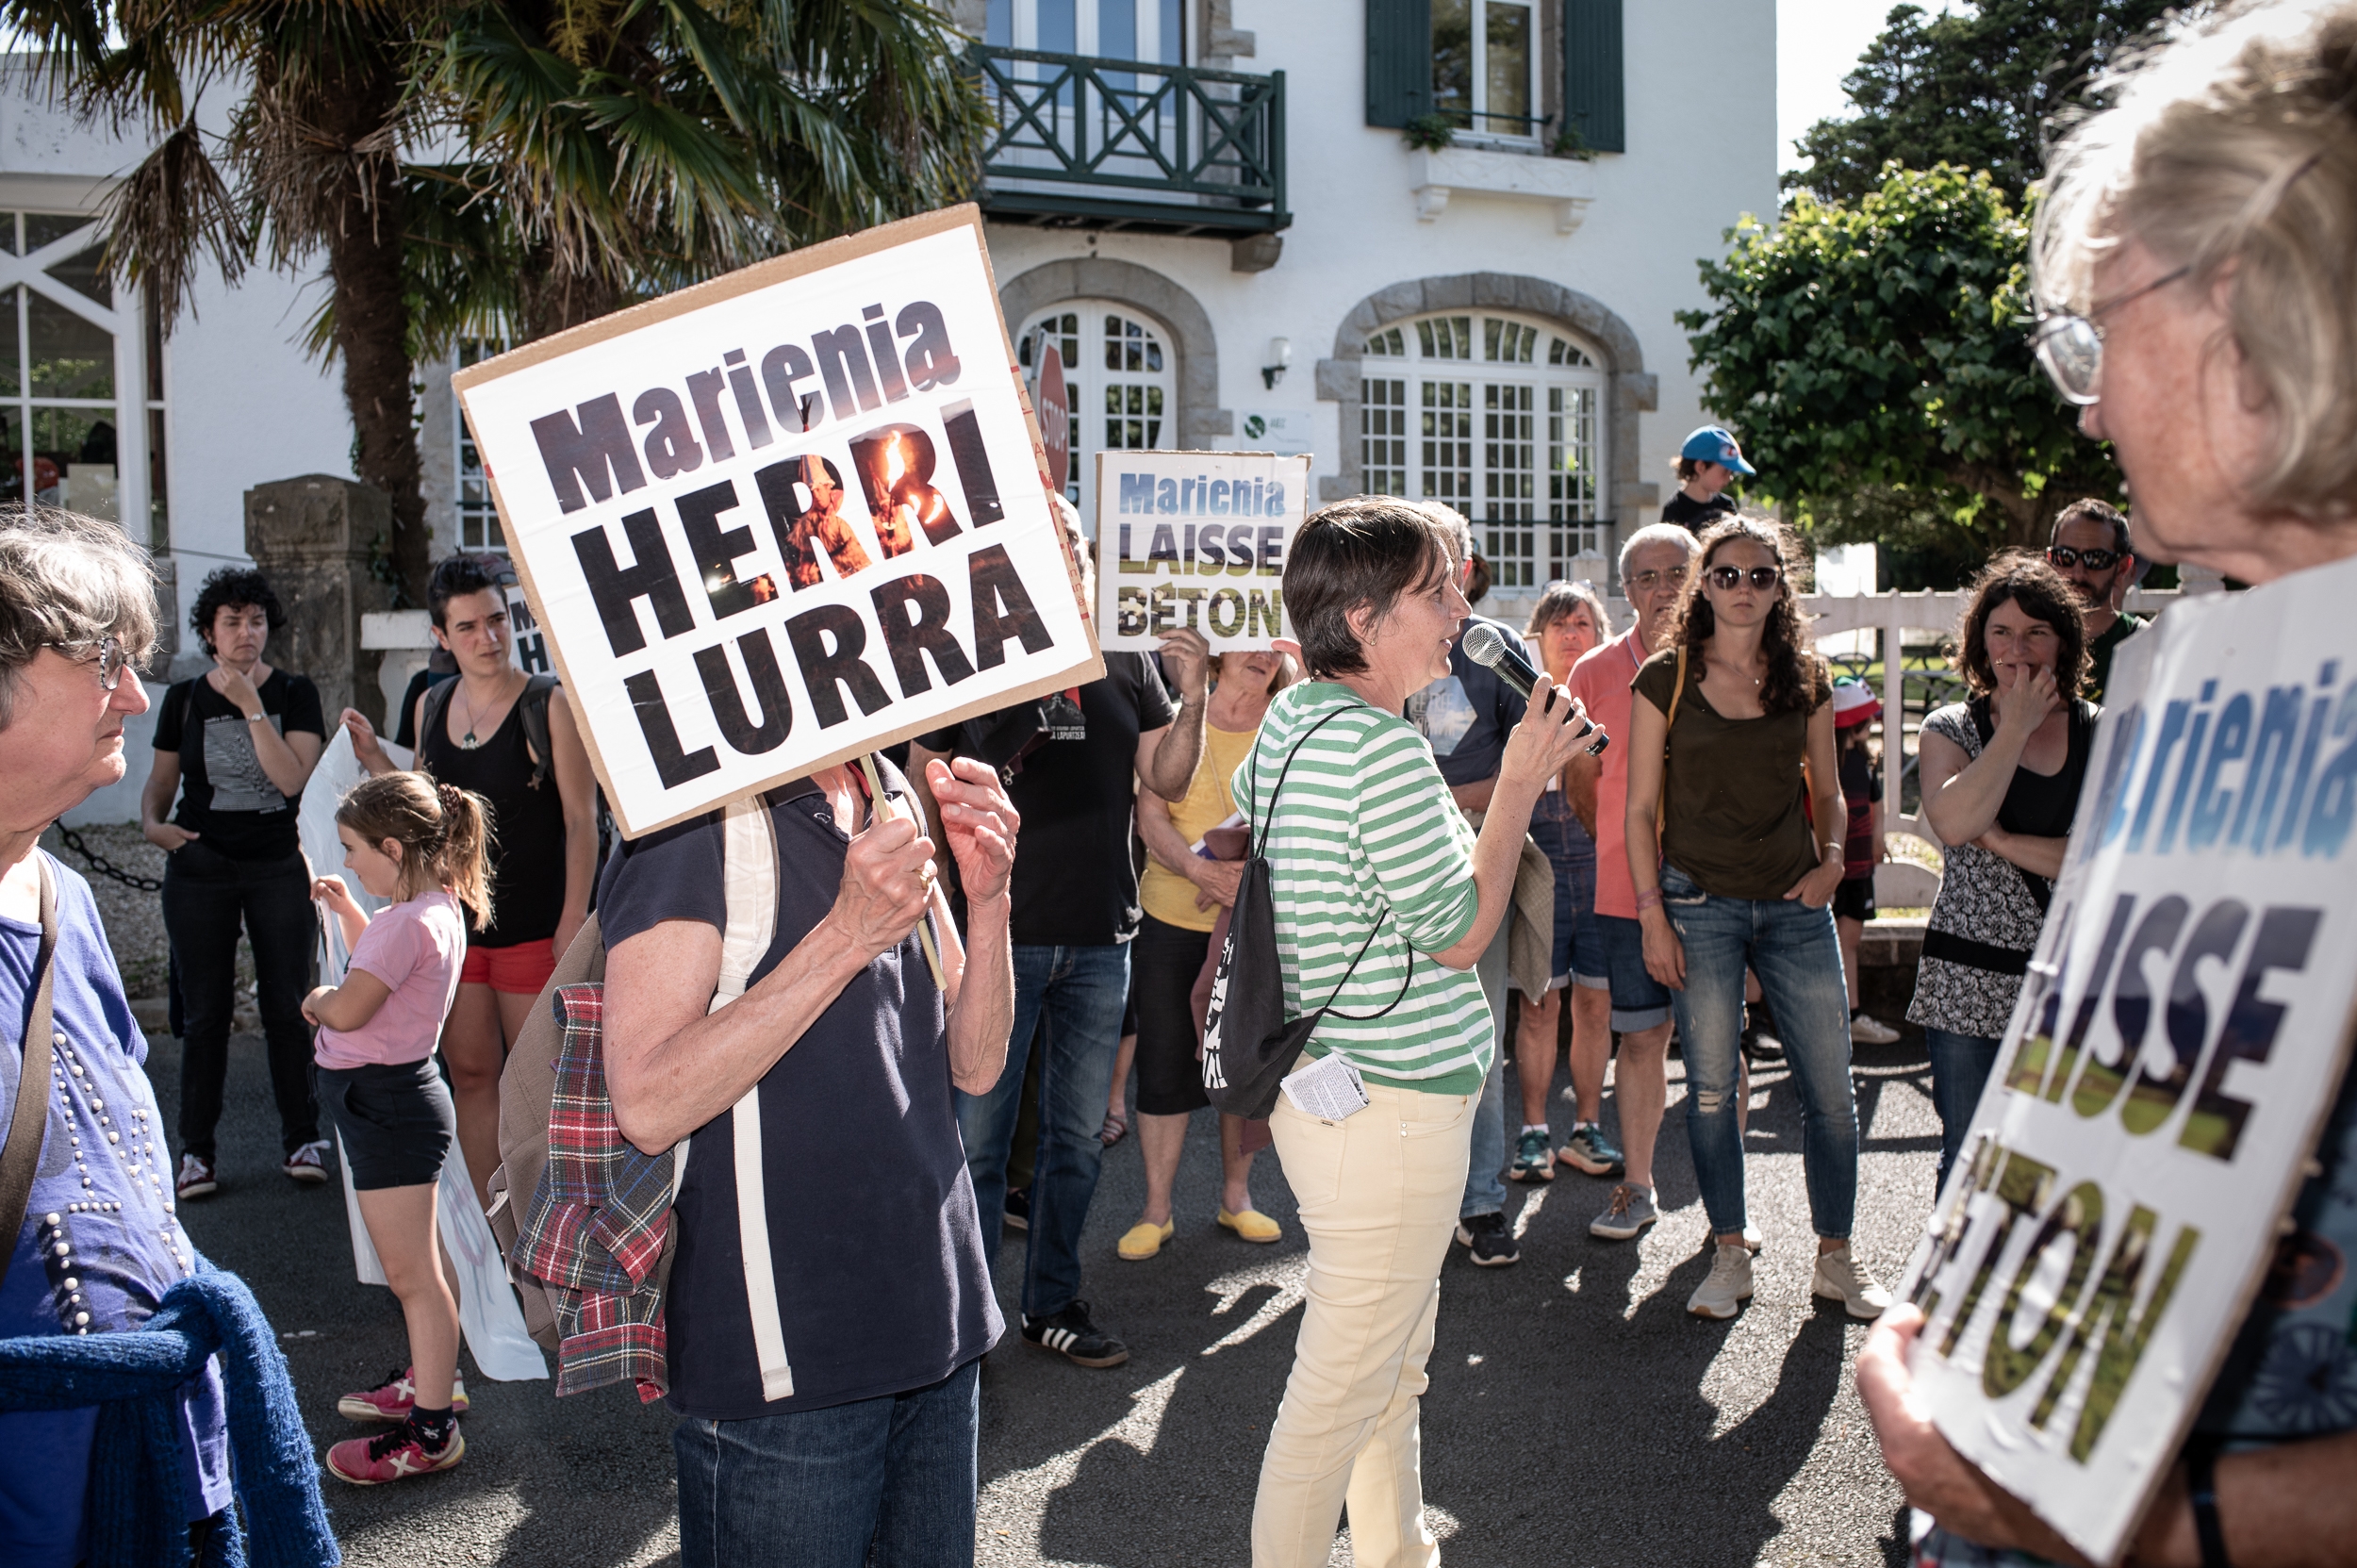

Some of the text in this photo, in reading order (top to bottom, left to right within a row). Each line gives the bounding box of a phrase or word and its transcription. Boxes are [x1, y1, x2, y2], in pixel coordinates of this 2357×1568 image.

[530, 300, 962, 516] Marienia
[1042, 395, 1067, 454] STOP
[1119, 472, 1286, 518] Marienia
[570, 397, 1005, 658] HERRI
[1117, 581, 1282, 638] BÉTON
[1118, 522, 1284, 577] LAISSE
[623, 543, 1054, 790] LURRA
[2080, 657, 2357, 865] rienia
[2004, 891, 2325, 1162] ISSE
